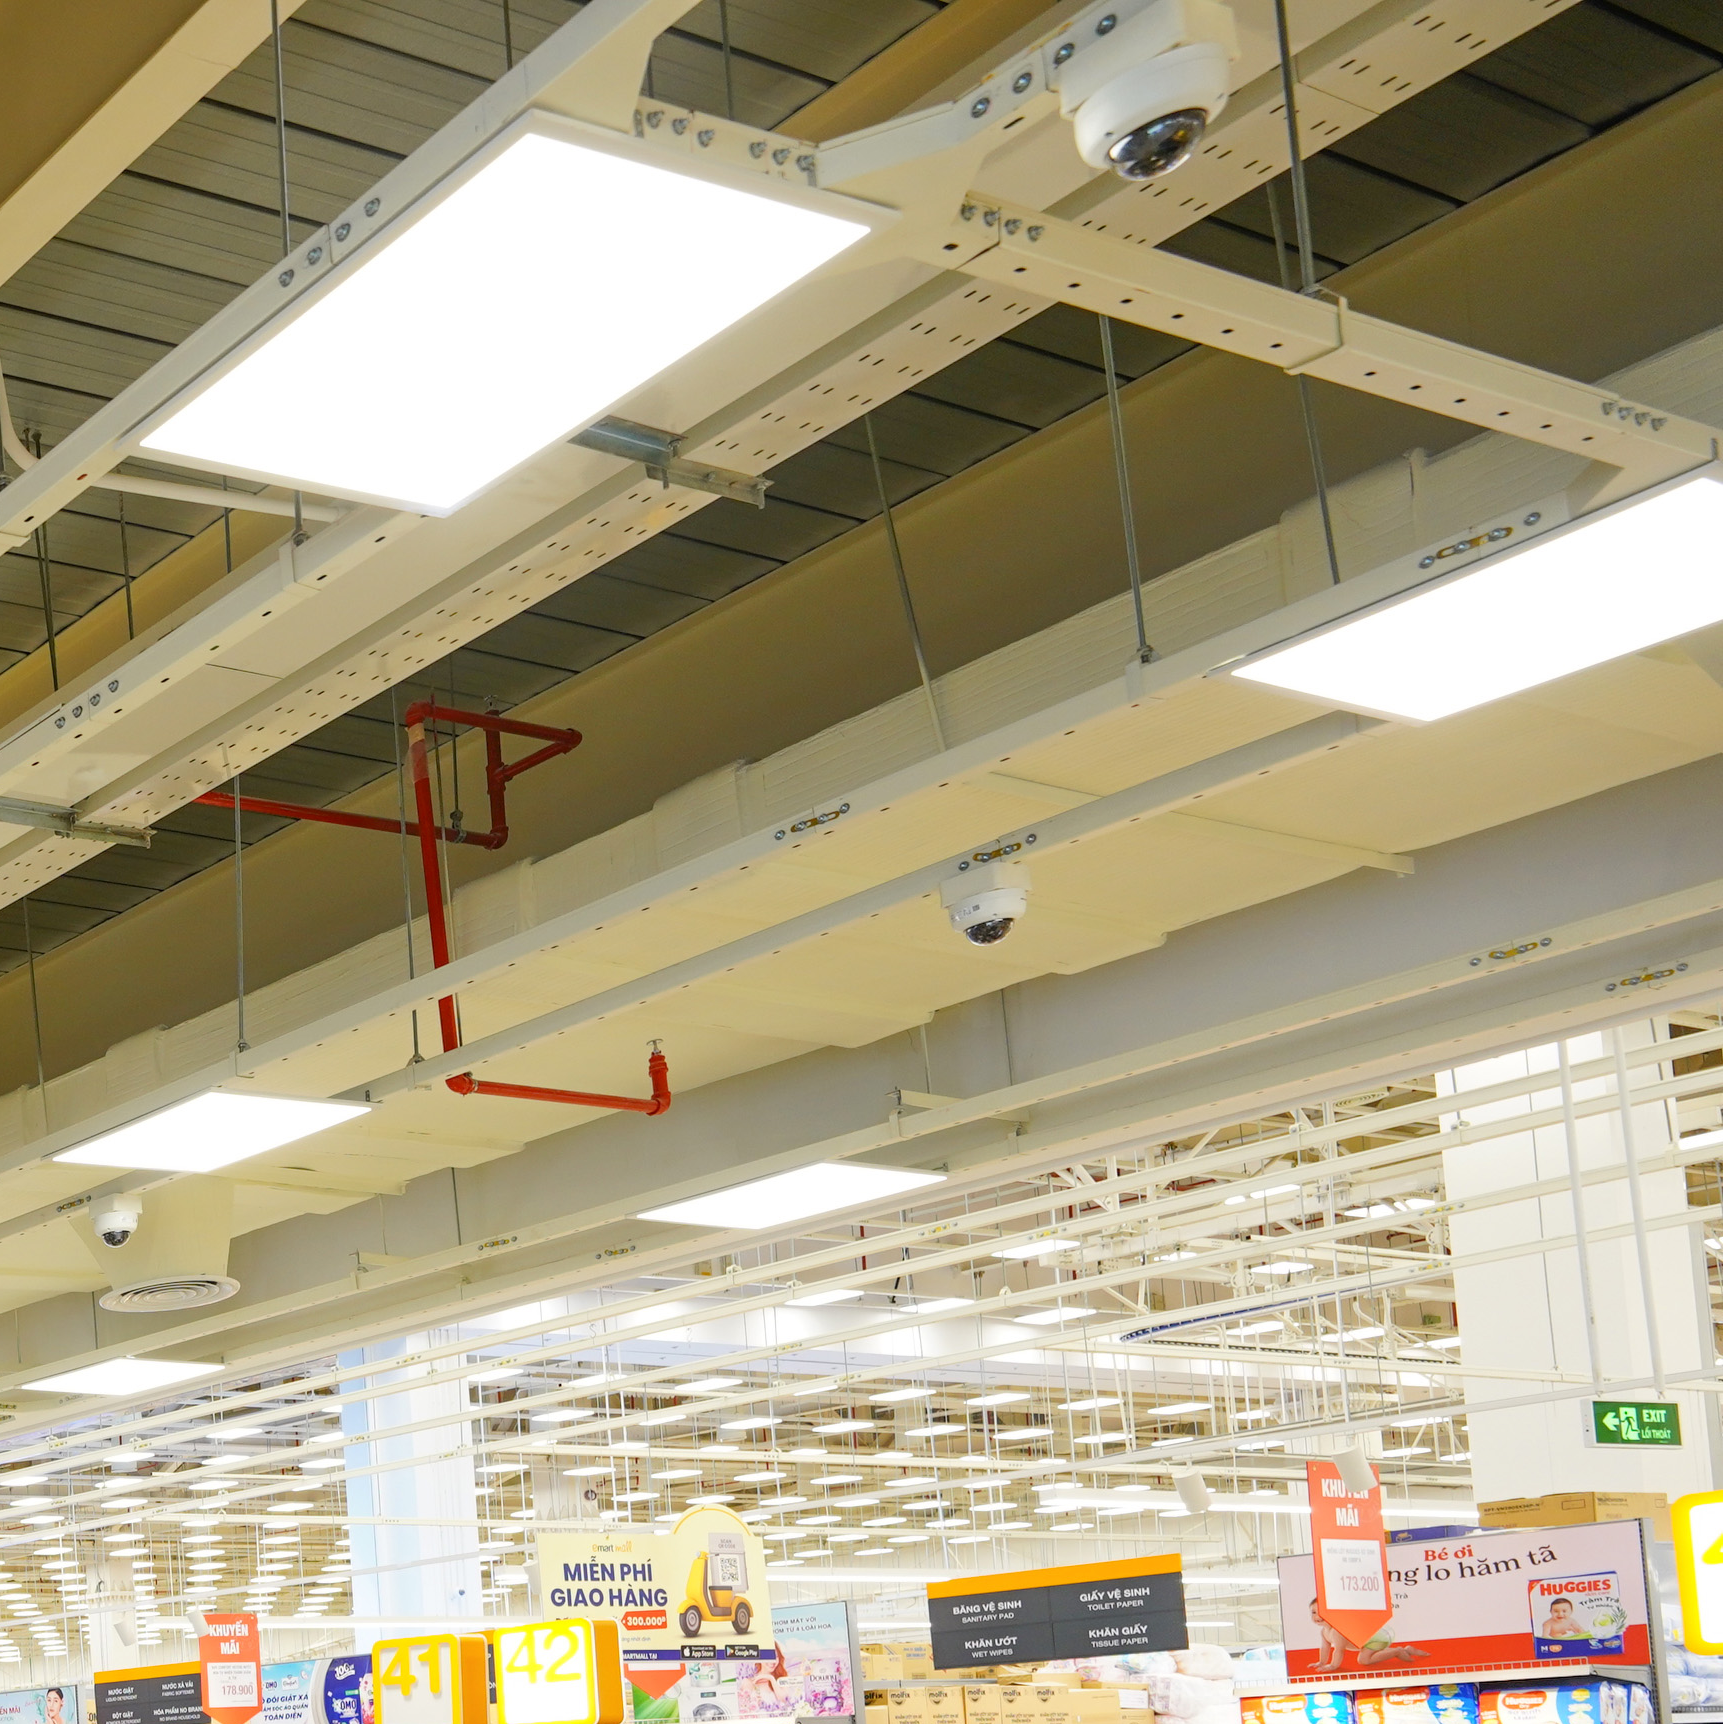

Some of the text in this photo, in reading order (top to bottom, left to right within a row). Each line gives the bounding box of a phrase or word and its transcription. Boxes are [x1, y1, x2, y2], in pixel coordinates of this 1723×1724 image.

[1642, 1409, 1667, 1423] EXIT
[1641, 1426, 1671, 1439] LỐI THOÁT
[1336, 1504, 1359, 1527] MÃI
[1424, 1545, 1473, 1561] Bé ơi
[564, 1556, 652, 1581] MIỄN PHÍ
[1425, 1565, 1450, 1581] lo
[1459, 1558, 1520, 1578] hăm
[1527, 1544, 1557, 1566] tã
[1080, 1586, 1150, 1602] GIẤY VỆ SINH
[1540, 1579, 1611, 1596] HUGGIES
[550, 1584, 668, 1607] GIAO HÀNG
[953, 1600, 1022, 1615] BĂNG VỆ SINH
[1087, 1599, 1144, 1611] TOILET PAPER
[962, 1612, 1014, 1623] SANITARY PAD
[210, 1620, 248, 1637] KHUYẾN
[1088, 1623, 1148, 1638] KHĂN GIẤY
[220, 1641, 240, 1655] MÃI
[965, 1634, 1017, 1649] KHĂN ƯỚT
[1091, 1636, 1148, 1648] TISSUE PAPER
[506, 1627, 581, 1683] 42
[972, 1648, 1013, 1659] WET WIPES
[382, 1645, 440, 1696] 41
[222, 1685, 253, 1696] 178.900
